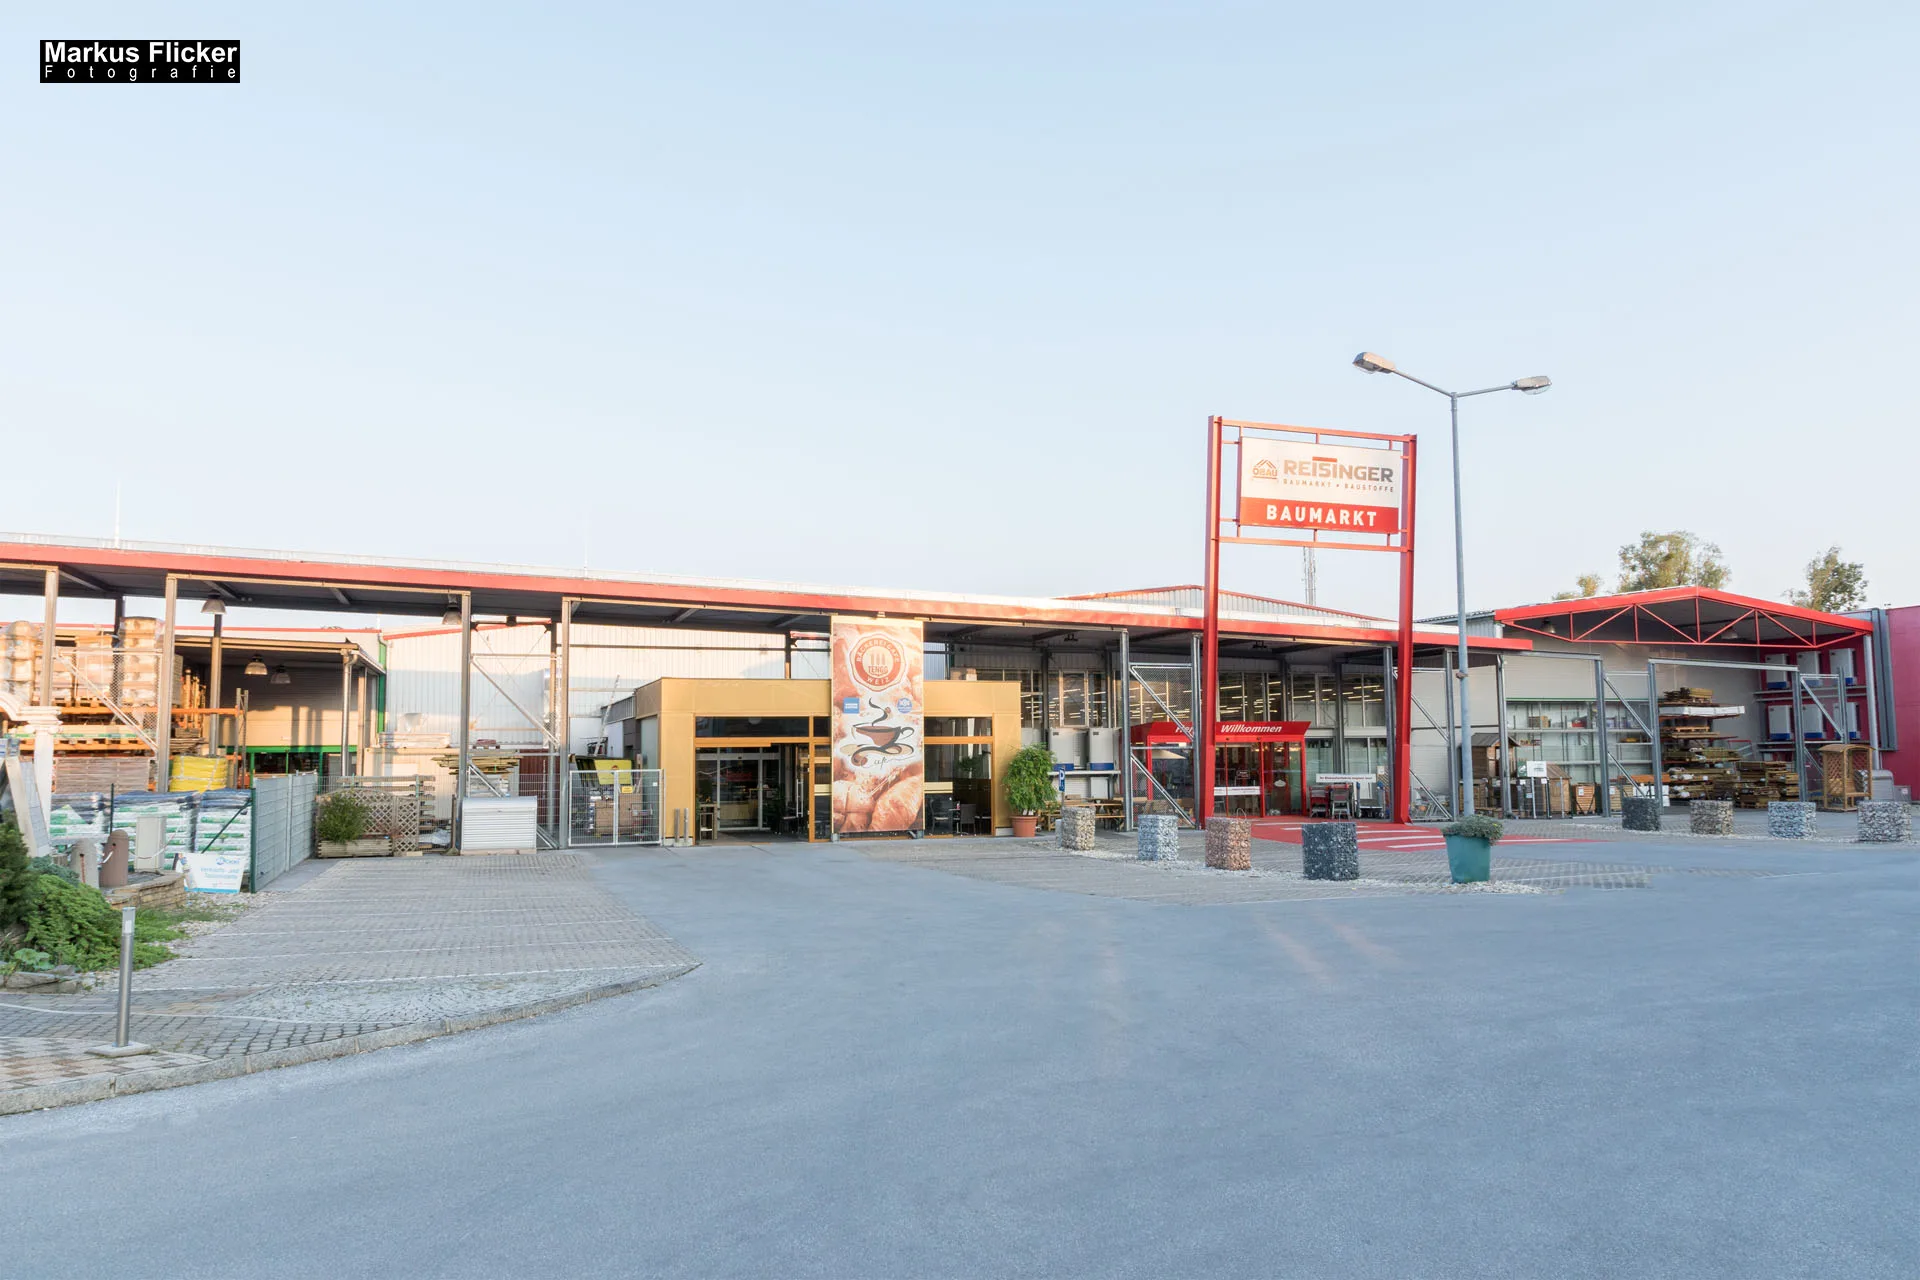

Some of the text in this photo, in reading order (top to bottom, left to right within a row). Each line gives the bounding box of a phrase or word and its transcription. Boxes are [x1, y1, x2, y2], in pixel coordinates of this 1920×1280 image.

[1284, 459, 1394, 483] REISINGER
[1283, 478, 1395, 493] BAUMARKT BAUSTOFFE
[1266, 504, 1377, 527] BAUMARKT
[867, 676, 889, 685] WEIZ
[1221, 724, 1283, 733] Willkommen
